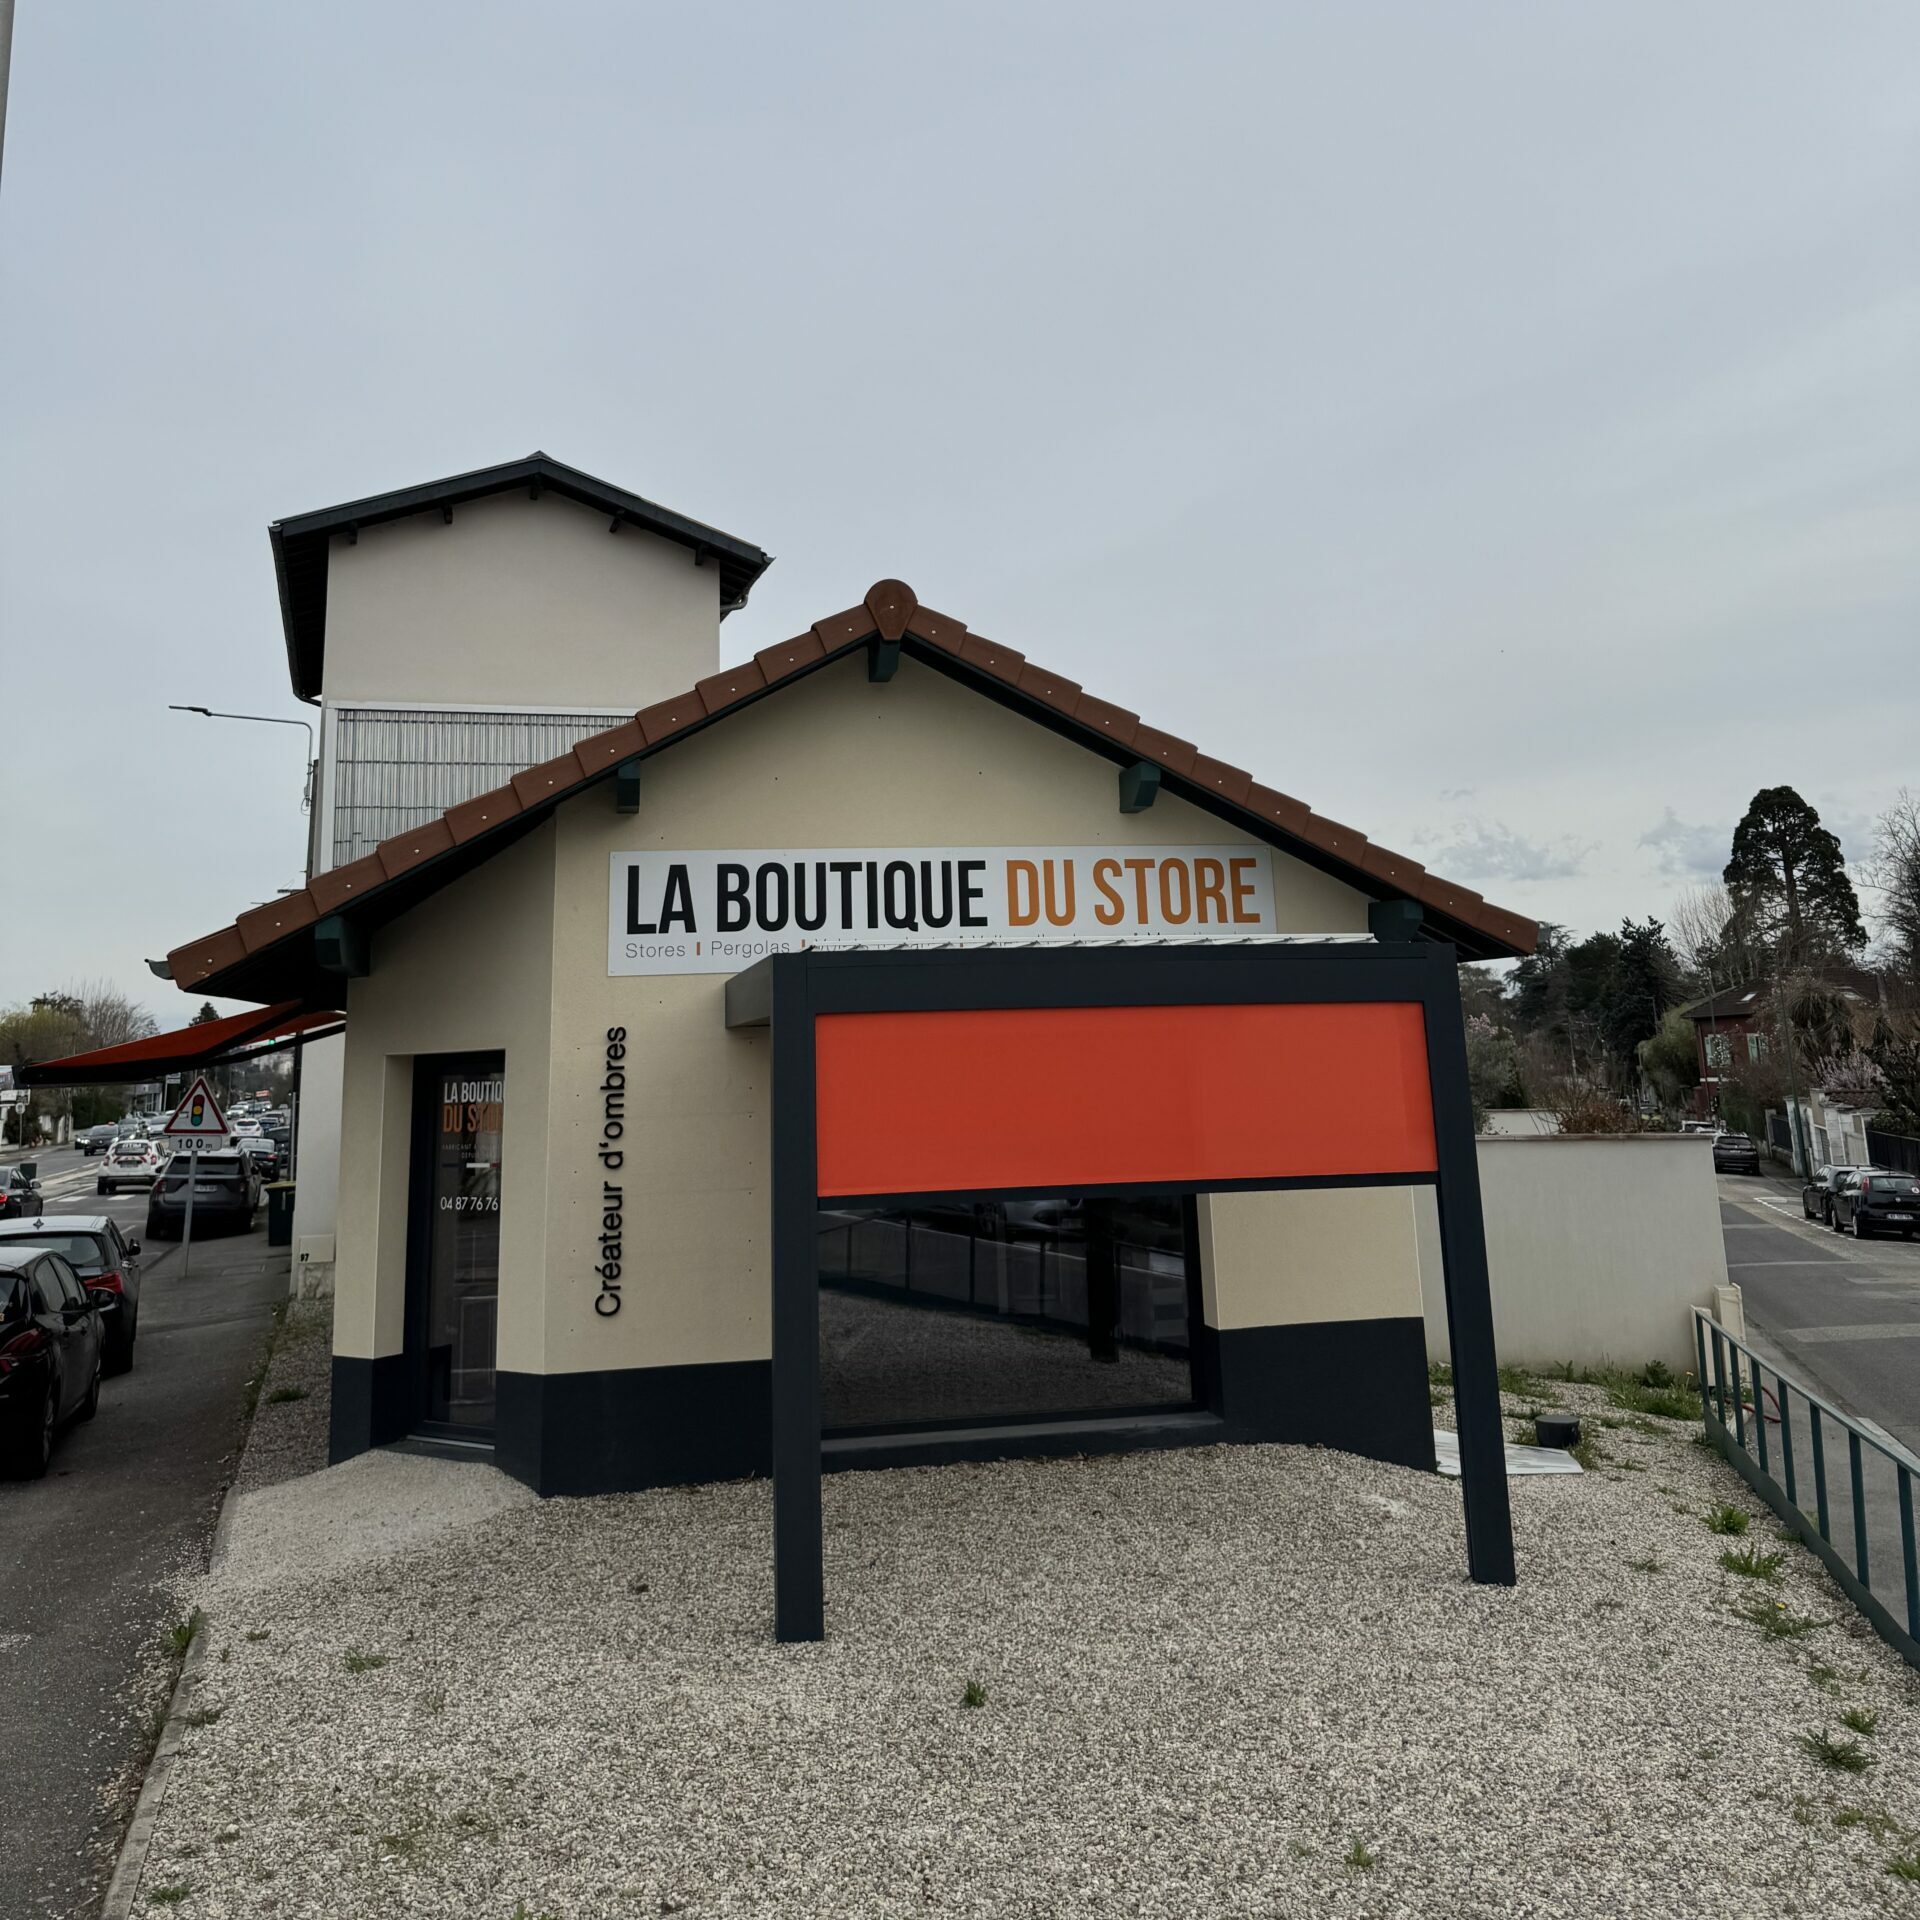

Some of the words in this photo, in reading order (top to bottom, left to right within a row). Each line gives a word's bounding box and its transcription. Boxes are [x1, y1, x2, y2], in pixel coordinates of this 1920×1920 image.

[626, 864, 697, 935] LA
[716, 860, 988, 933] BOUTIQUE
[1006, 859, 1076, 927] DU
[1092, 857, 1261, 926] STORE
[625, 942, 686, 959] Stores
[711, 939, 790, 959] Pergolas
[443, 1082, 458, 1104] LA
[460, 1080, 504, 1103] BOUTIQ
[598, 1025, 627, 1170] d'ombres
[443, 1104, 463, 1132] DU
[177, 1138, 204, 1150] 100
[440, 1196, 453, 1210] 04
[455, 1196, 469, 1210] 87
[470, 1196, 483, 1211] 76
[485, 1196, 499, 1211] 76
[594, 1181, 623, 1317] Créateur
